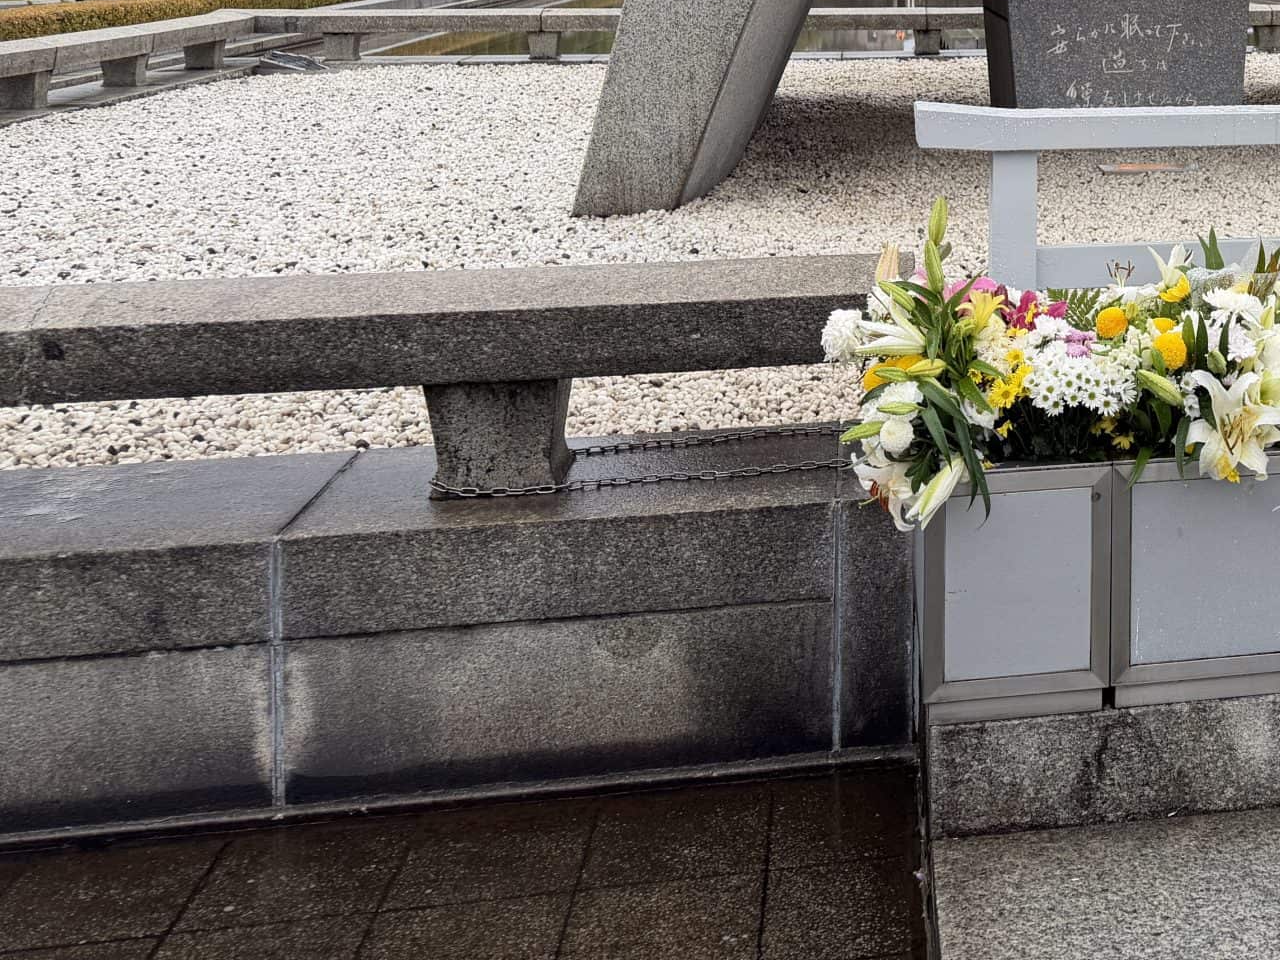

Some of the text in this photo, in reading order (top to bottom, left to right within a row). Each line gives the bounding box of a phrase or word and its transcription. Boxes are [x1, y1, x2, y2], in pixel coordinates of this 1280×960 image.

[1047, 13, 1203, 54] 安らかに眠って下さい
[1102, 48, 1168, 74] 過ちは
